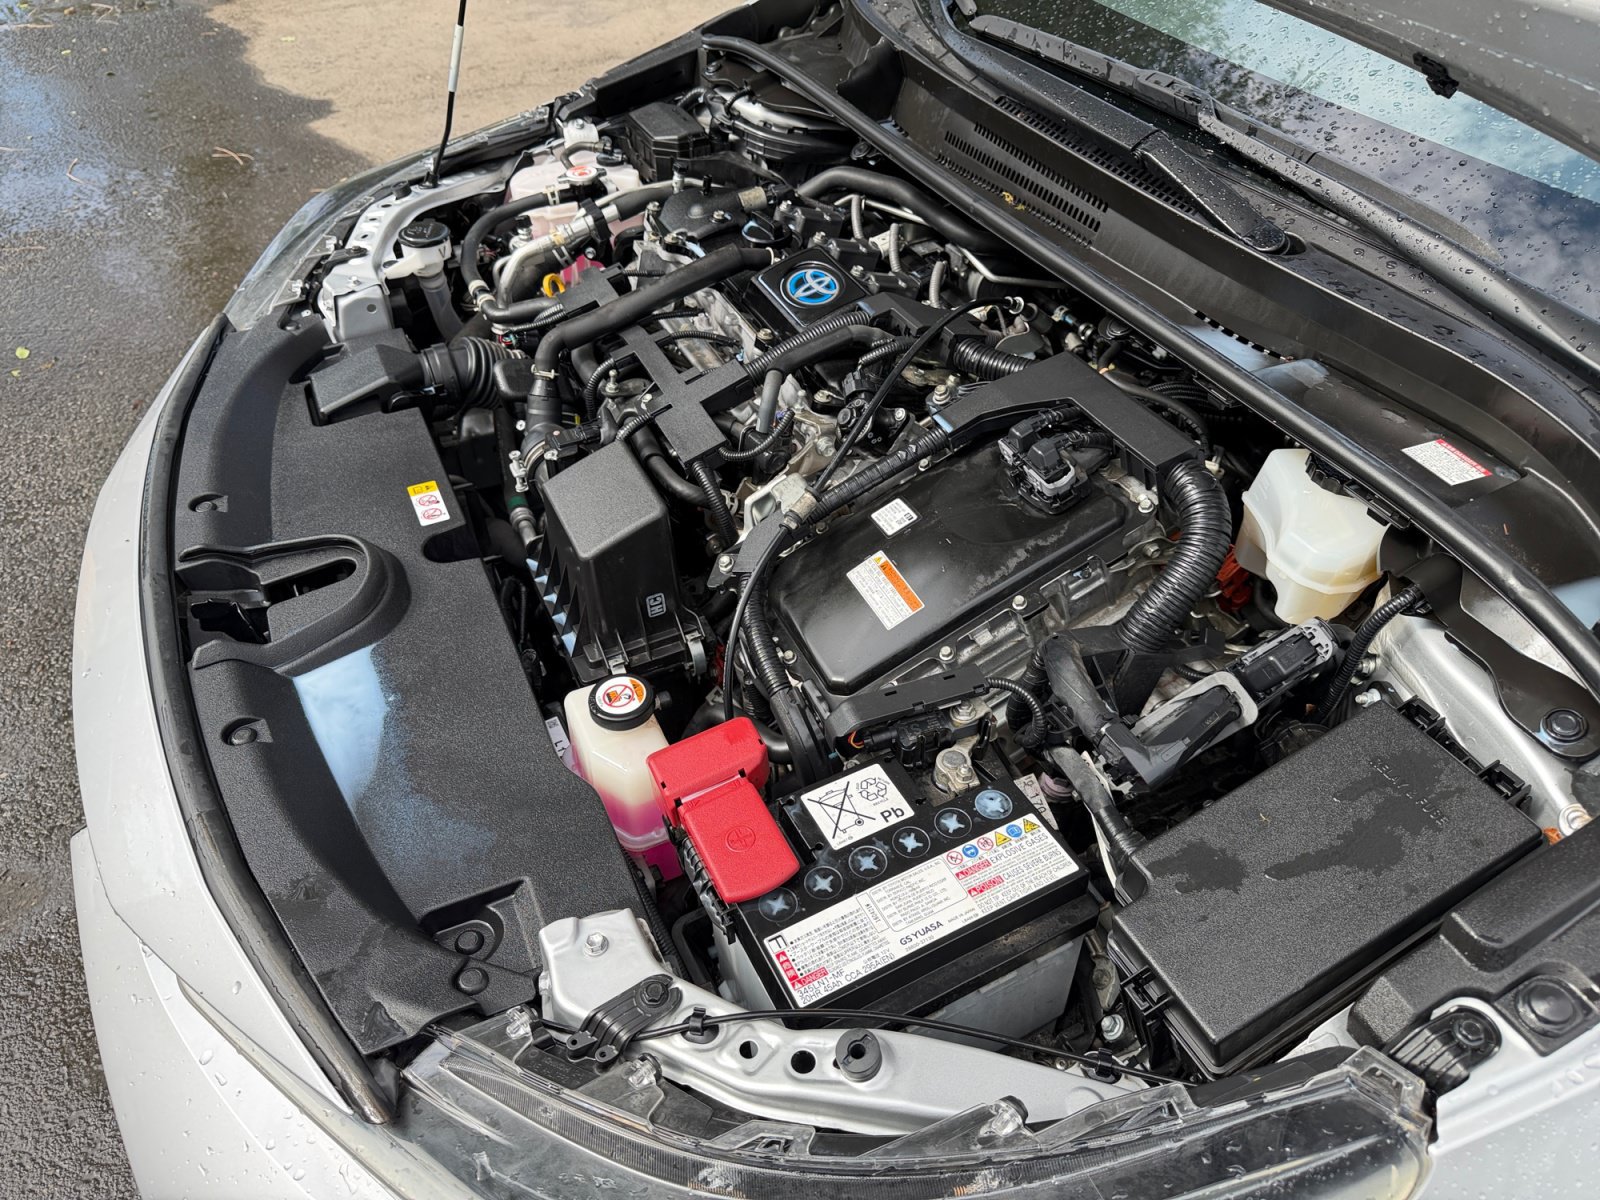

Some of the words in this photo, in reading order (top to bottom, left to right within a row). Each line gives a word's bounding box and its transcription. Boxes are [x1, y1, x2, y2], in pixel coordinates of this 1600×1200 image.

[880, 807, 905, 823] Pb
[989, 843, 1025, 863] EXPLOSIVE
[1024, 832, 1048, 847] GASES
[898, 935, 912, 945] GS
[910, 920, 943, 939] YUASA
[796, 968, 846, 997] 345LN1-MF
[800, 968, 827, 985] DANGER
[800, 989, 823, 1004] 20HR
[821, 978, 843, 993] 45Ah
[844, 969, 862, 982] CCA
[861, 952, 896, 973] 295A(EN)
